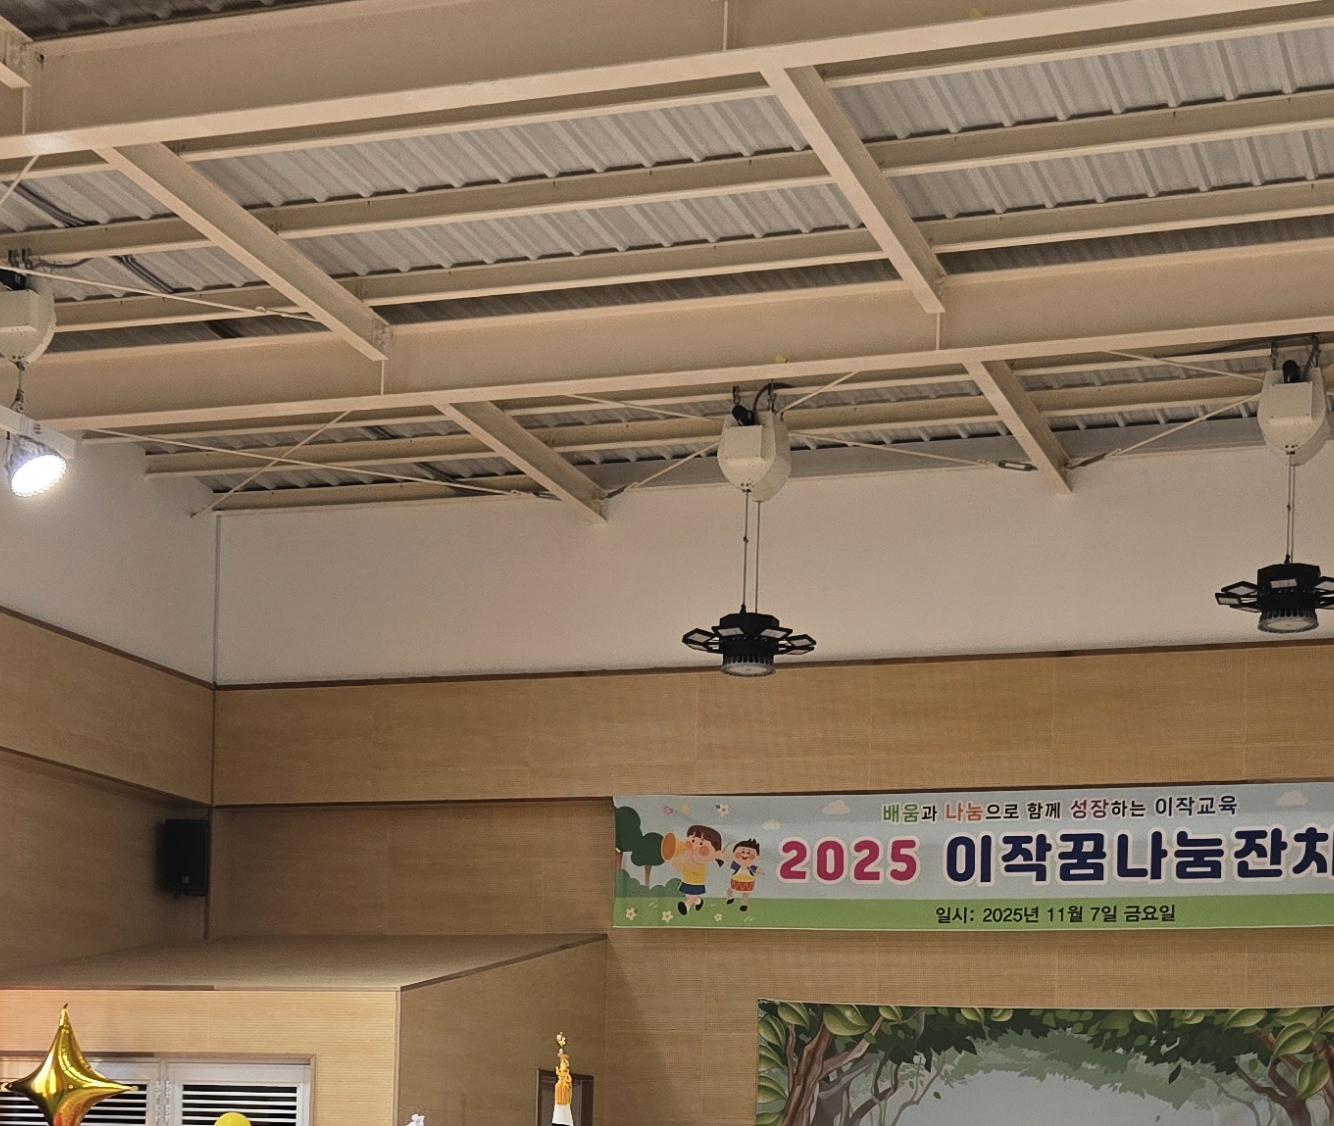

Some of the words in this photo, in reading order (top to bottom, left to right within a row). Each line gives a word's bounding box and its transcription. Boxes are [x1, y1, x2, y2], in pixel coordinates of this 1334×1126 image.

[882, 803, 937, 822] 배움과
[945, 803, 1019, 821] 나눔으로
[1027, 801, 1061, 819] 함께
[1070, 799, 1146, 819] 성장하는
[1155, 795, 1237, 817] 이작교육
[780, 839, 917, 881] 2025
[935, 907, 974, 924] 일시:
[982, 906, 1039, 923] 2025년
[1047, 905, 1083, 923] 11월
[1090, 905, 1117, 923] 7일
[1124, 904, 1176, 922] 금요일
